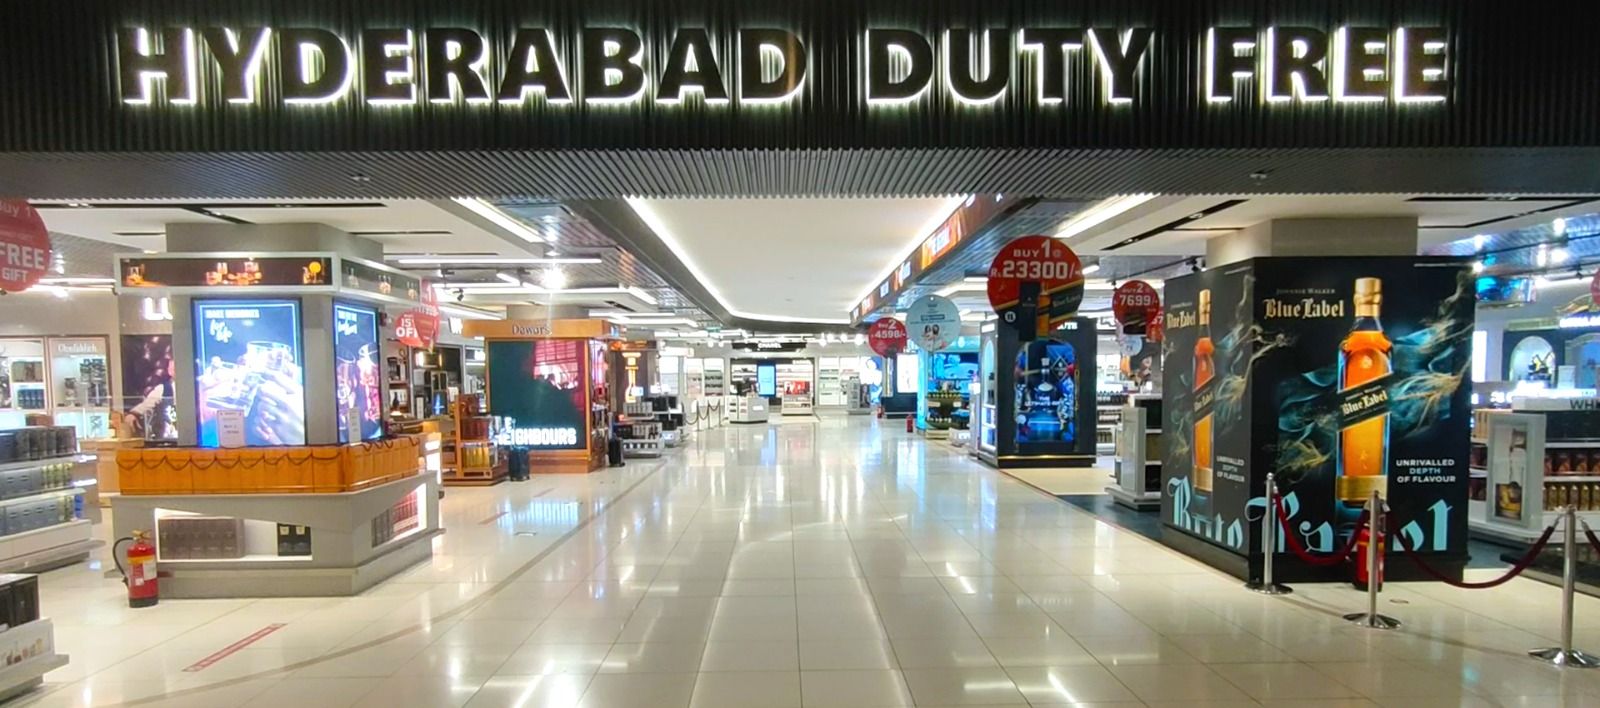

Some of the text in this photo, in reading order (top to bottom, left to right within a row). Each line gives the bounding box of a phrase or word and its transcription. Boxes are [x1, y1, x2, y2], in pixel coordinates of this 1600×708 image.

[116, 27, 1449, 104] HYDERABAD DUTY FREE
[1013, 249, 1039, 257] BUY
[1041, 239, 1051, 258] 1
[2, 267, 28, 282] GIFT
[1136, 282, 1144, 293] 2
[1263, 298, 1345, 319] Blue Label
[888, 319, 897, 330] 2
[1409, 467, 1441, 475] DEPTH
[1412, 475, 1456, 483] FLAVOUR
